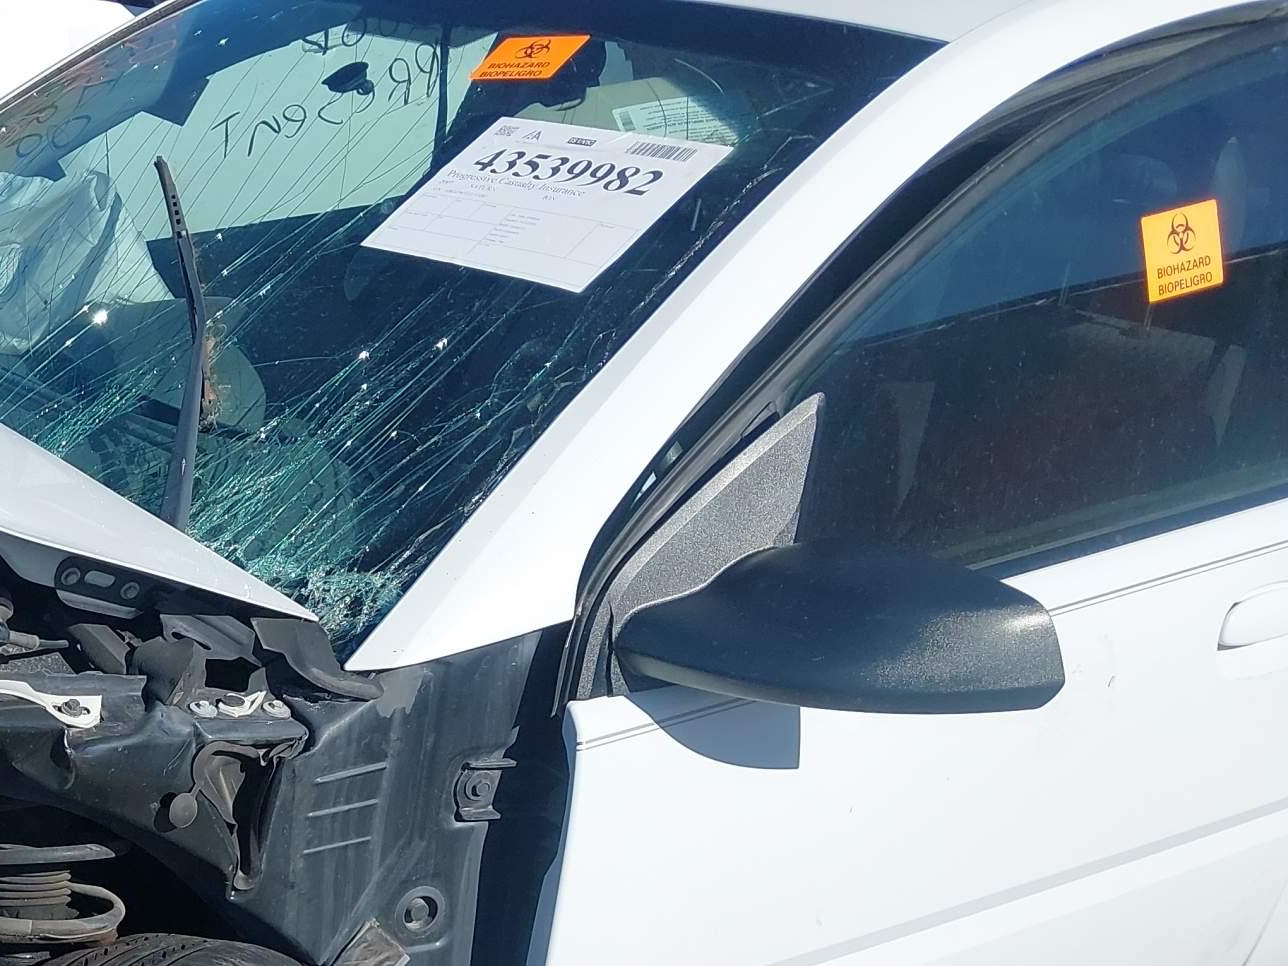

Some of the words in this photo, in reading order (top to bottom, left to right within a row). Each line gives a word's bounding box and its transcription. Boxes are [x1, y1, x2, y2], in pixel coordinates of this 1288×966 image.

[487, 61, 551, 69] BIOHAZARD
[447, 169, 498, 184] Progressive
[498, 176, 536, 191] Casualty
[537, 182, 586, 198] Insurance
[473, 148, 664, 196] 43539982
[1156, 255, 1212, 280] BIOHAZARD
[1158, 271, 1213, 297] BIOPELIGRO
